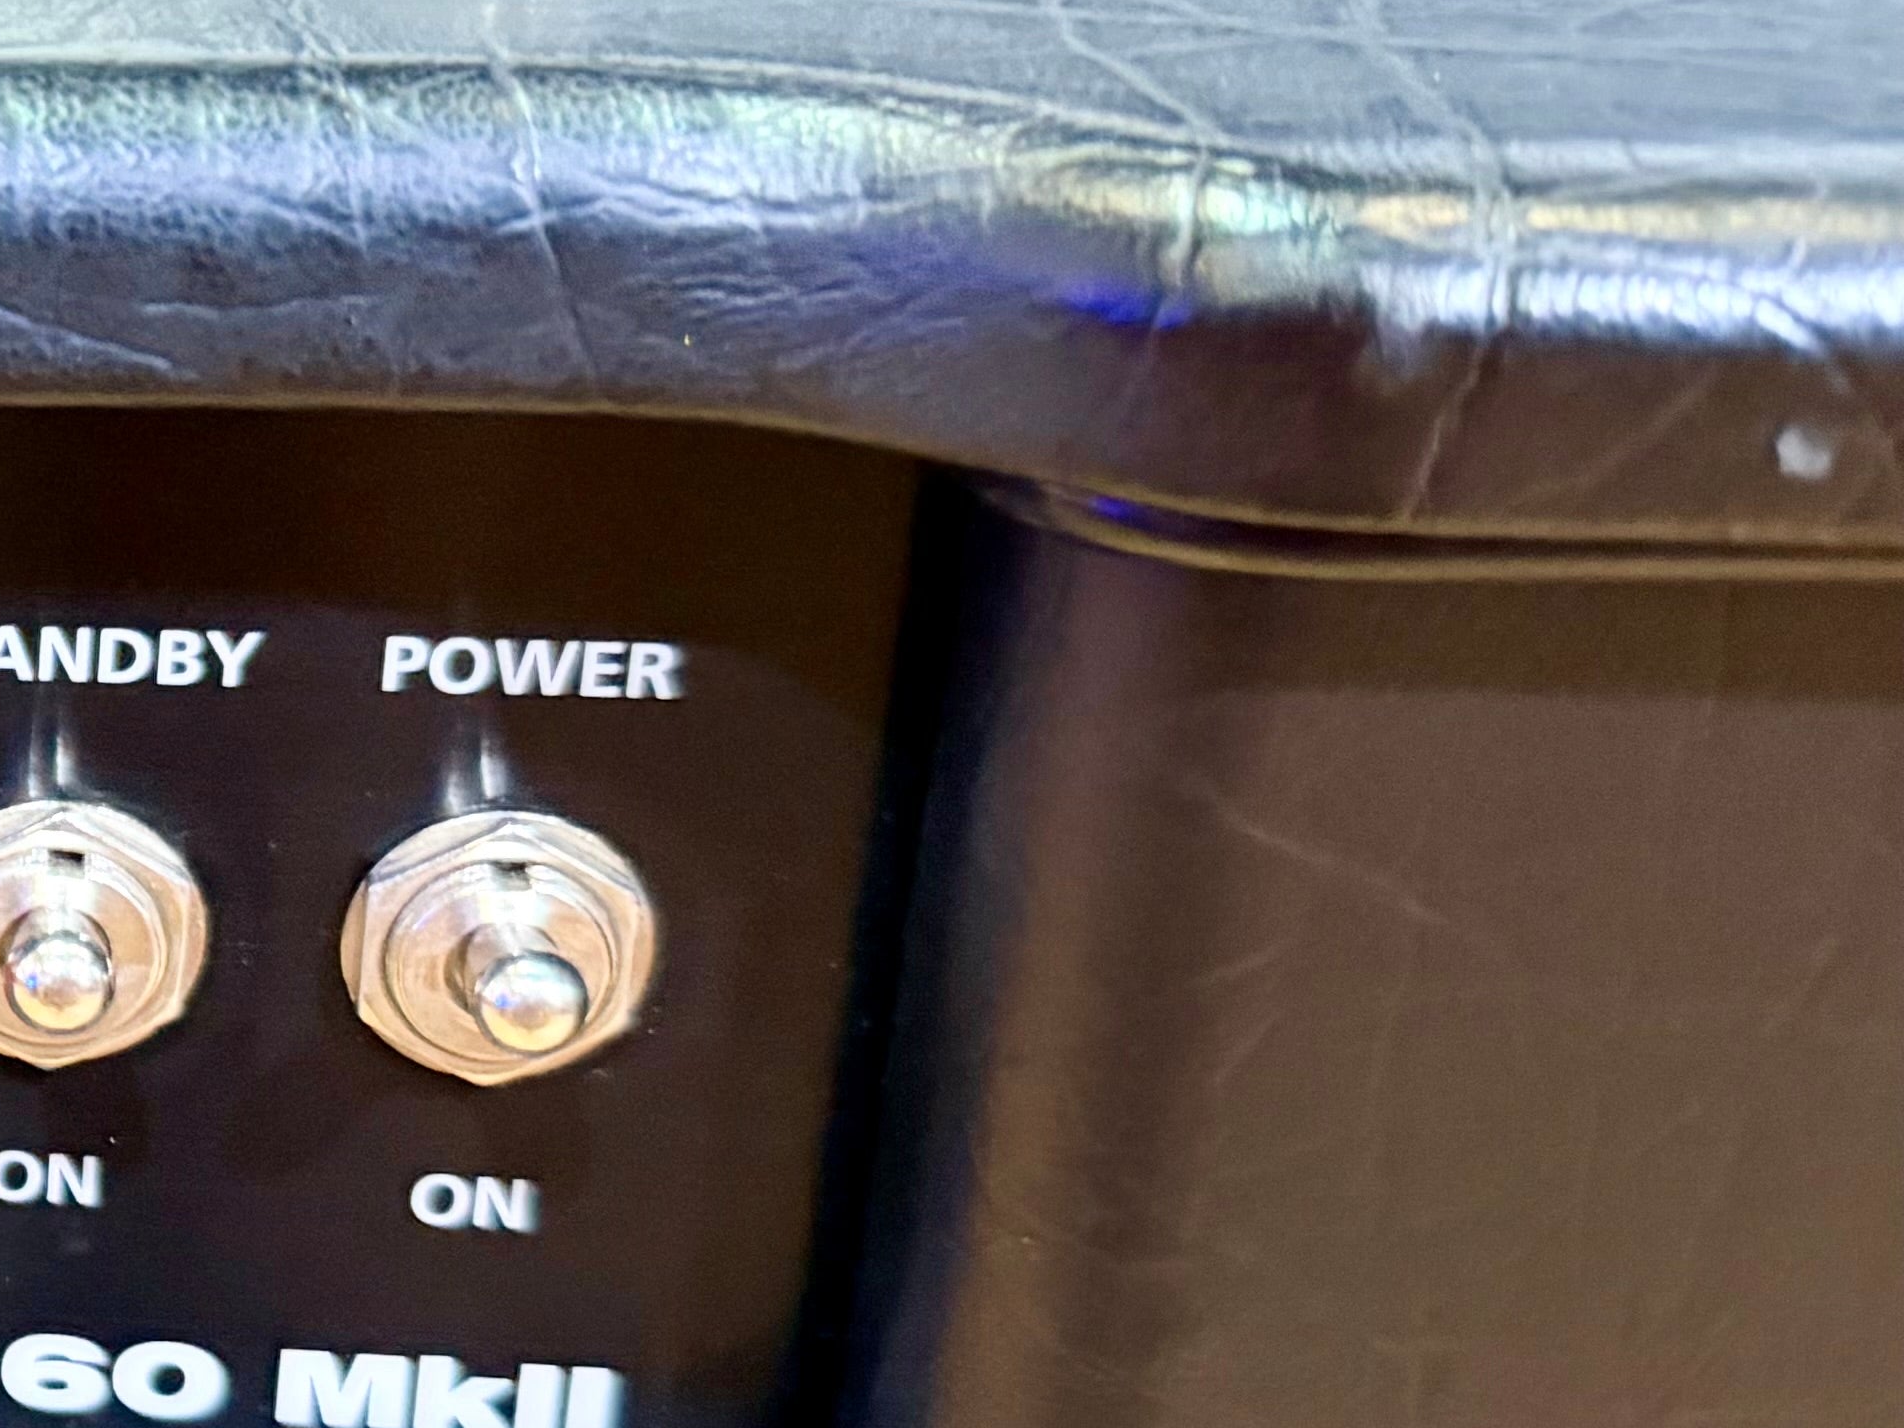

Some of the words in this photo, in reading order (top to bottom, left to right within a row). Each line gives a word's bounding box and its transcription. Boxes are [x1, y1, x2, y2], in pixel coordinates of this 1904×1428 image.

[382, 636, 680, 699] POWER
[411, 1174, 532, 1231] ON
[1, 1334, 228, 1420] 60
